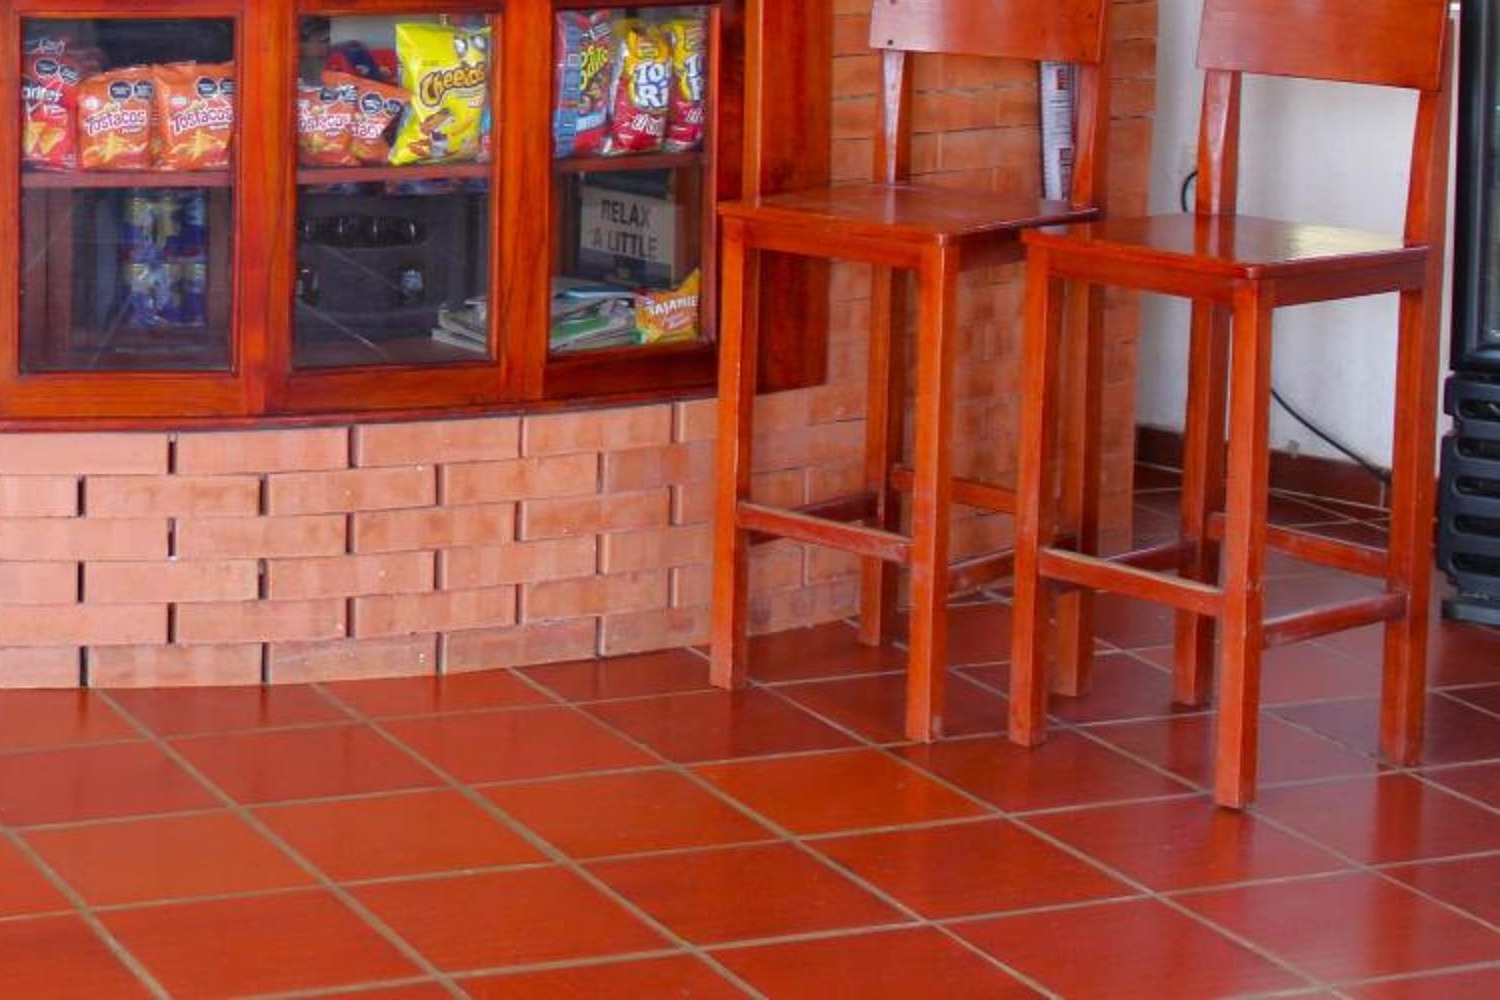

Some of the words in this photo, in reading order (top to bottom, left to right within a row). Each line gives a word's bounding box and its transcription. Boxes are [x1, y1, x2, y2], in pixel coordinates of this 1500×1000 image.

[86, 109, 147, 135] Tostacos
[172, 107, 235, 136] Tostacos
[601, 199, 650, 229] RELAX
[607, 230, 658, 258] LITTLE
